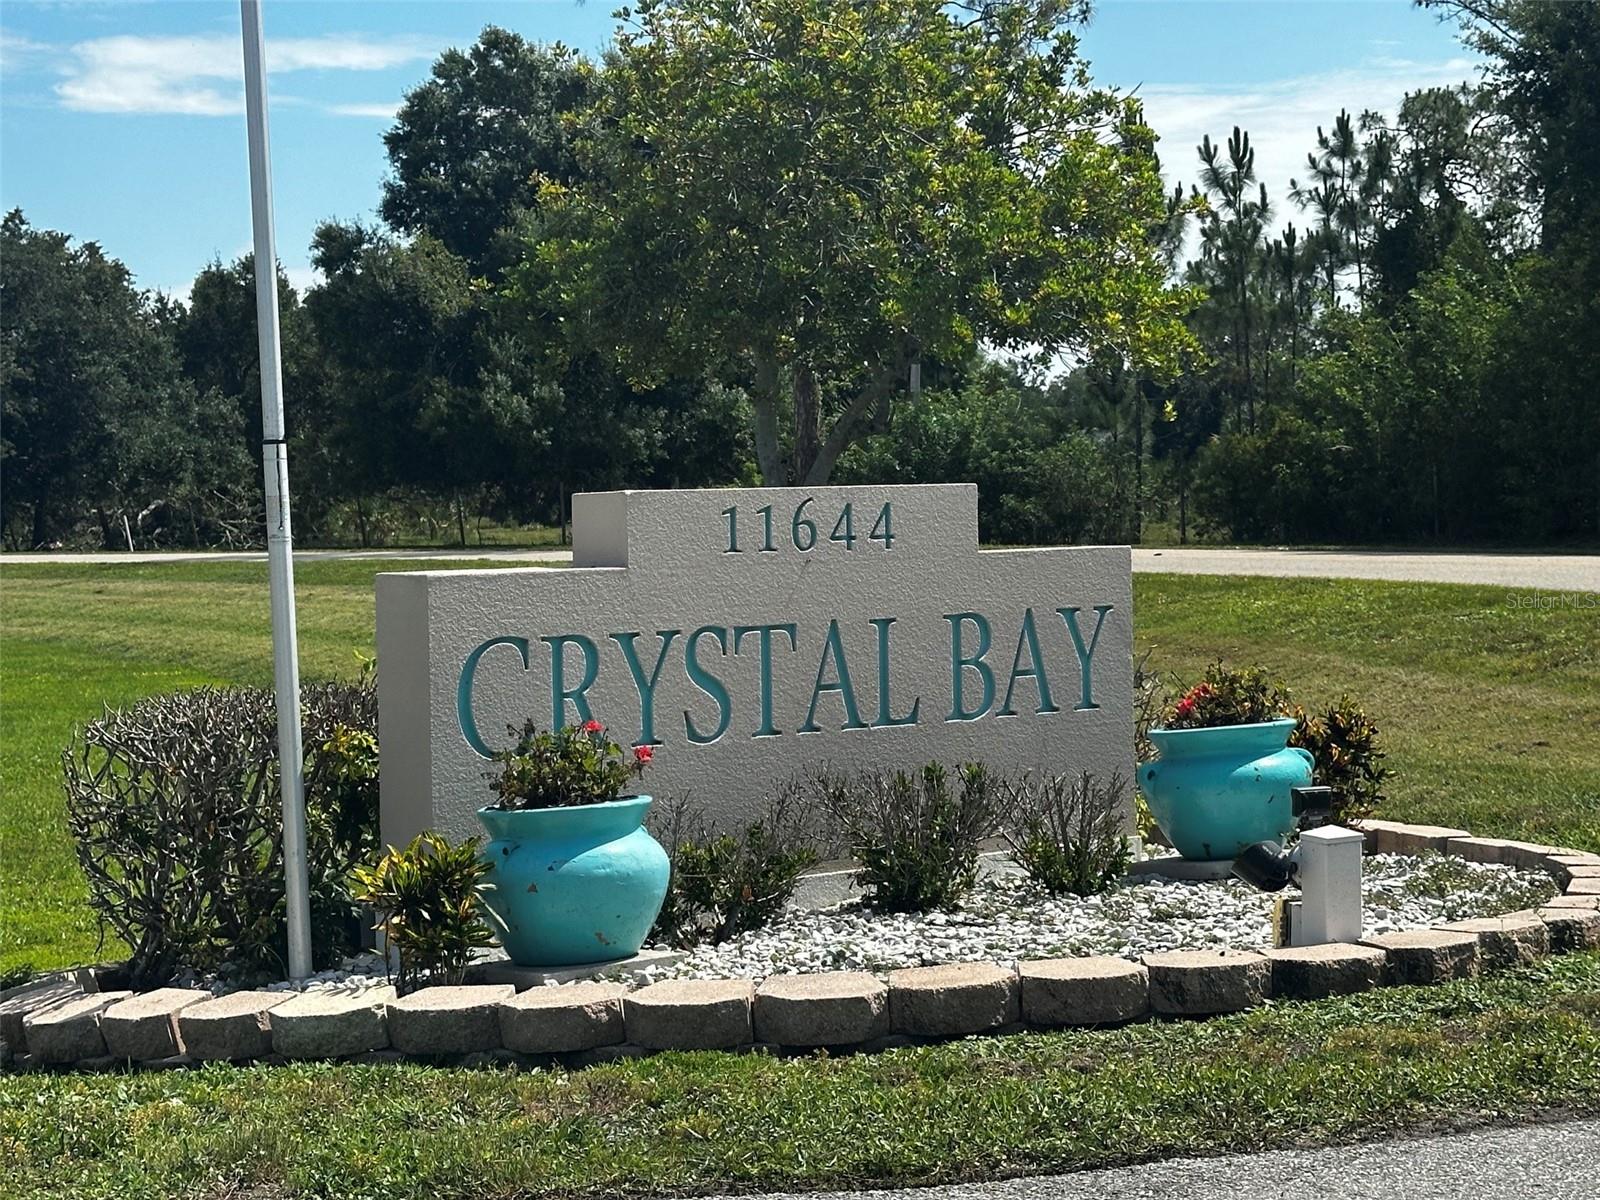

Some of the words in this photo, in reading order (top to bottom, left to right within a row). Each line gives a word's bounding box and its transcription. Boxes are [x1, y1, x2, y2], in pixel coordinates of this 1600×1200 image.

[721, 497, 896, 554] 11644
[456, 617, 920, 761] CRYSTAL
[943, 604, 1114, 723] BAY
